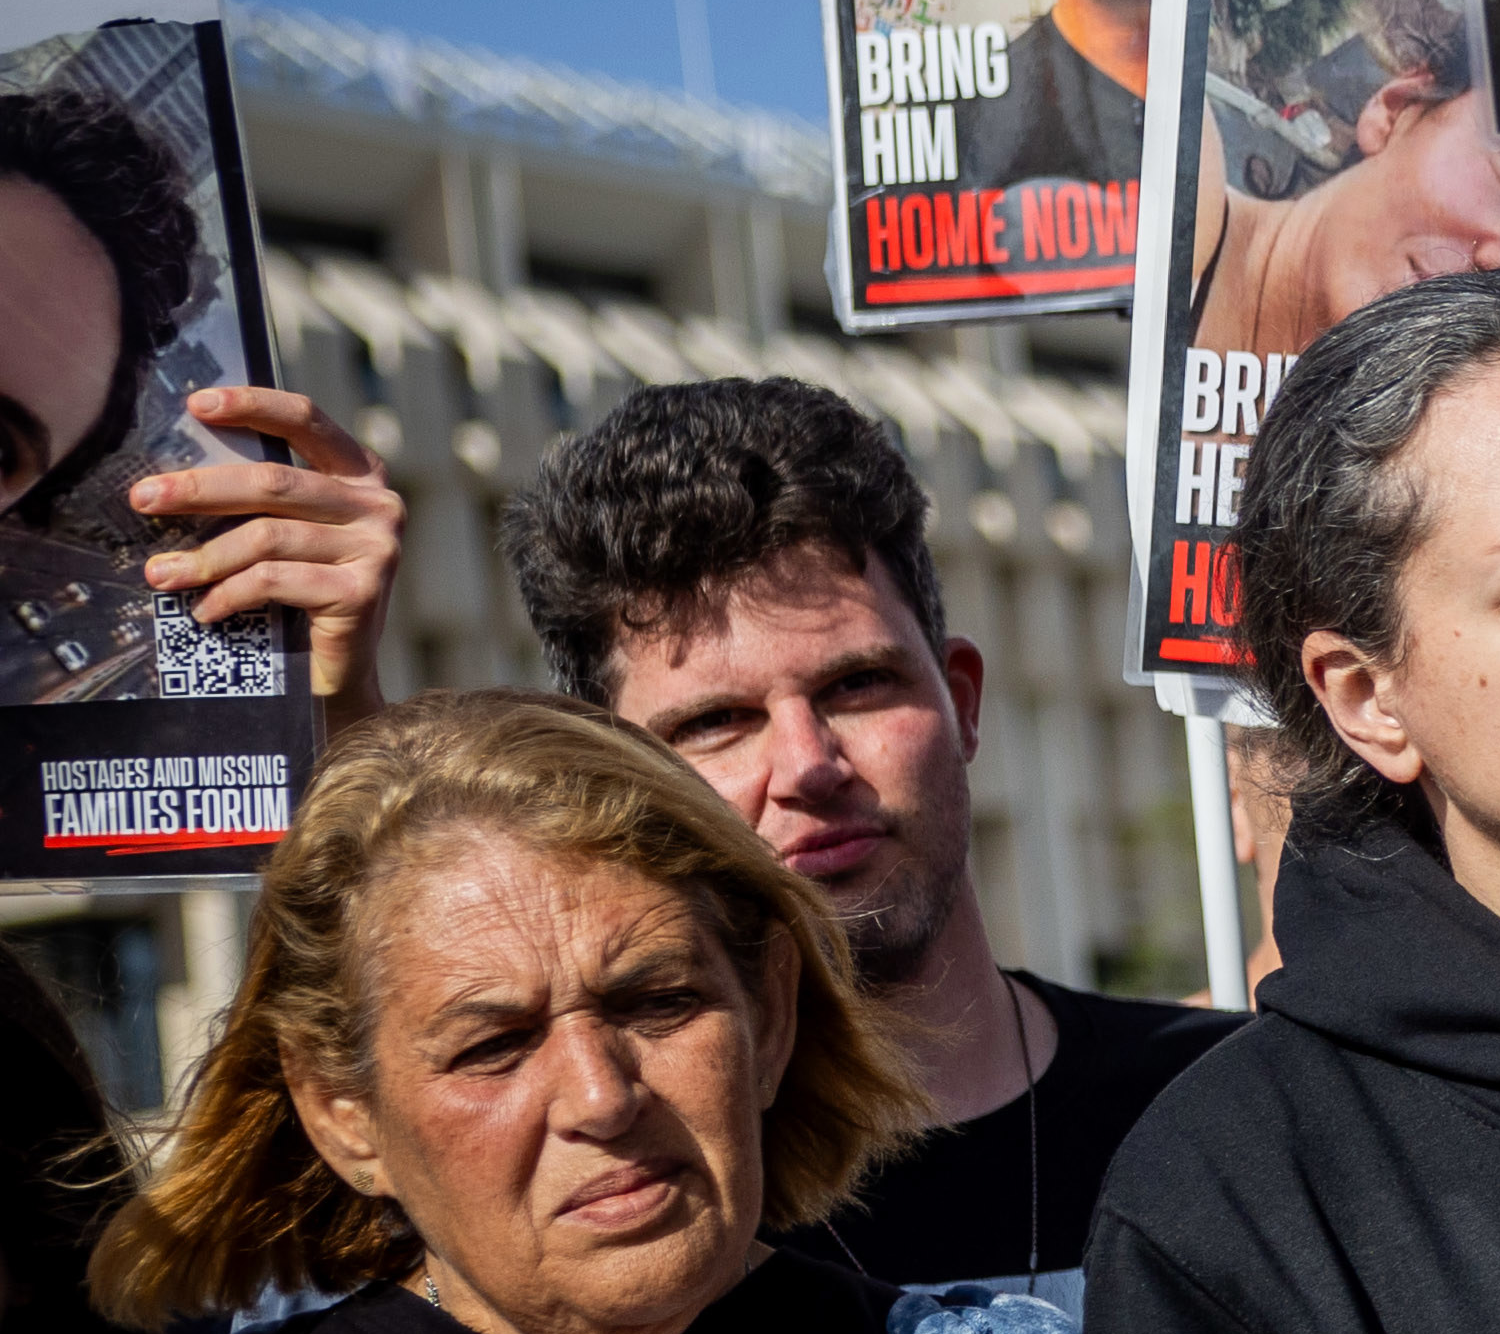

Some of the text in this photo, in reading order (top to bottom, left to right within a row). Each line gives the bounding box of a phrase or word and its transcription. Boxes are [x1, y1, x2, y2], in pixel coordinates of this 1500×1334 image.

[856, 22, 1009, 107] BRING
[860, 104, 959, 186] HIM
[866, 190, 1009, 273] HOME
[1175, 441, 1250, 526] HE
[42, 755, 286, 791] HOSTAGES AND MISSING
[45, 787, 289, 837] FAMILIES FORUM
